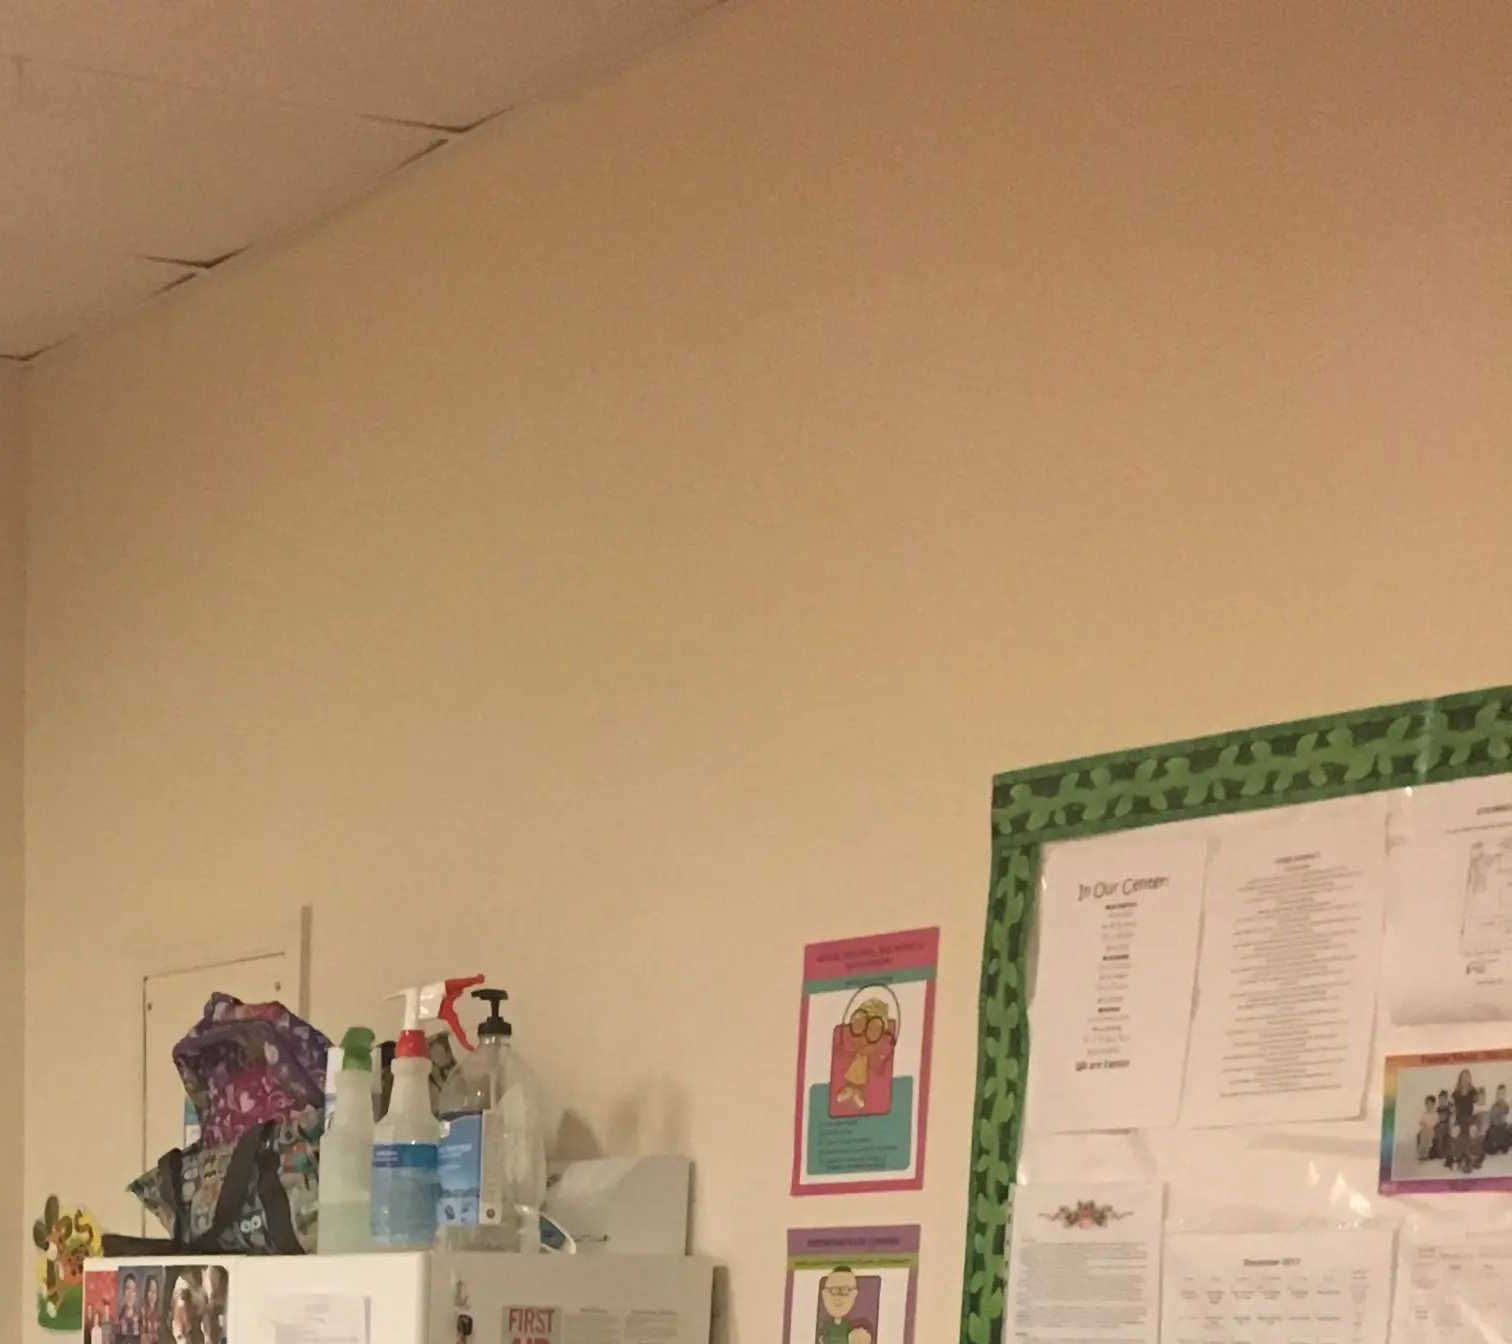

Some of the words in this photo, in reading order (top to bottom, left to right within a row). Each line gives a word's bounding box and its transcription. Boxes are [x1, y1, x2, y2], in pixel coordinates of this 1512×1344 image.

[1077, 884, 1091, 901] In
[1092, 881, 1120, 899] Our
[508, 1307, 556, 1333] FIRST
